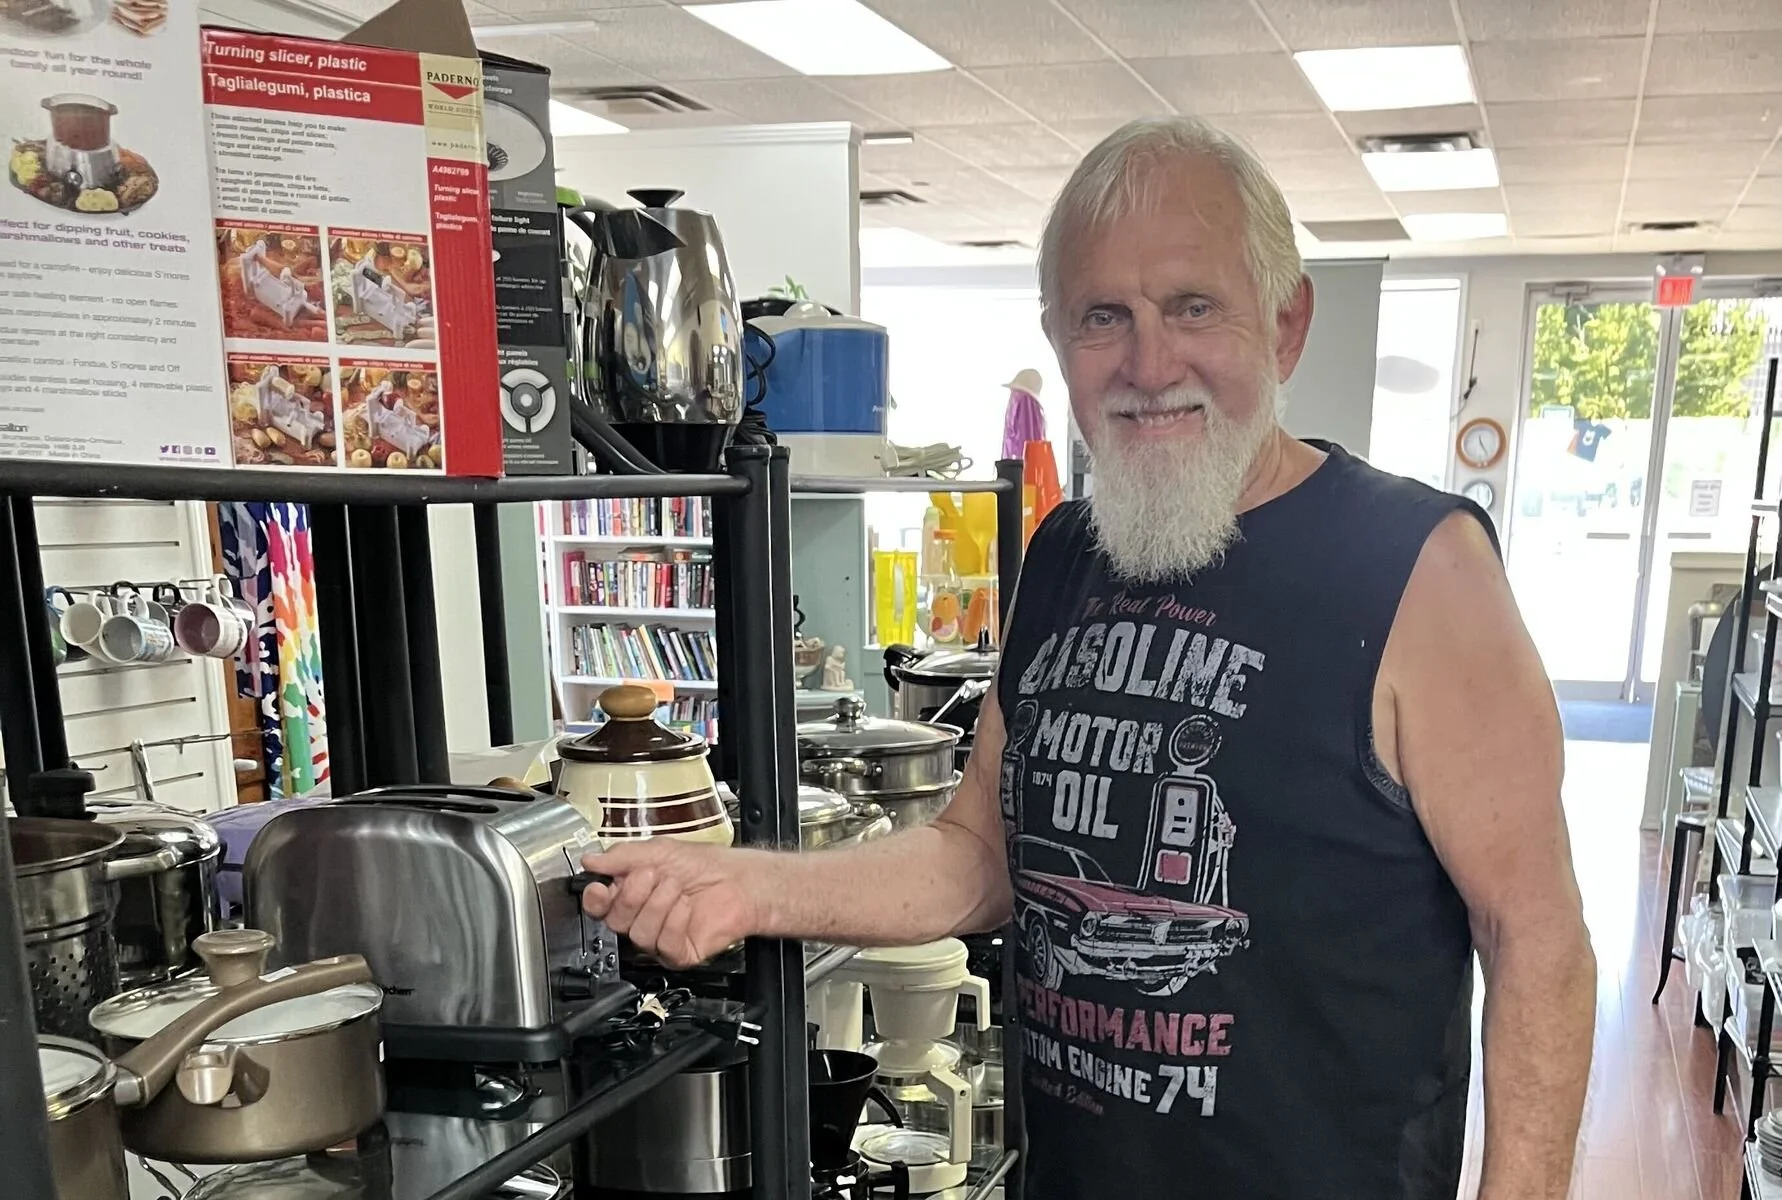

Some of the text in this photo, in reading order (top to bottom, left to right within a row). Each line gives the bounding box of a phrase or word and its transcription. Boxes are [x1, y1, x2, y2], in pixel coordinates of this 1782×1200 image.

[45, 51, 65, 60] fun
[69, 52, 87, 62] for
[91, 55, 111, 65] the
[115, 59, 152, 69] whole
[206, 40, 367, 72] Turning slicer, plastic
[70, 66, 99, 76] year
[426, 72, 479, 87] PADERNO
[208, 72, 371, 103] Taglialegumi, plastica
[434, 184, 461, 195] Turning
[33, 222, 52, 230] for
[55, 223, 101, 237] dipping
[105, 226, 134, 238] fruit,
[138, 230, 190, 243] cookies,
[85, 237, 108, 247] and
[112, 239, 146, 250] other
[150, 242, 186, 253] treats
[155, 318, 162, 326] 2
[1109, 591, 1148, 616] Real
[1154, 592, 1217, 627] Power
[1018, 621, 1266, 719] GASOLINE
[1030, 709, 1164, 774] MOTOR
[1051, 769, 1119, 839] OIL
[1068, 1045, 1152, 1104] ENGINE
[1156, 1064, 1218, 1116] 74
